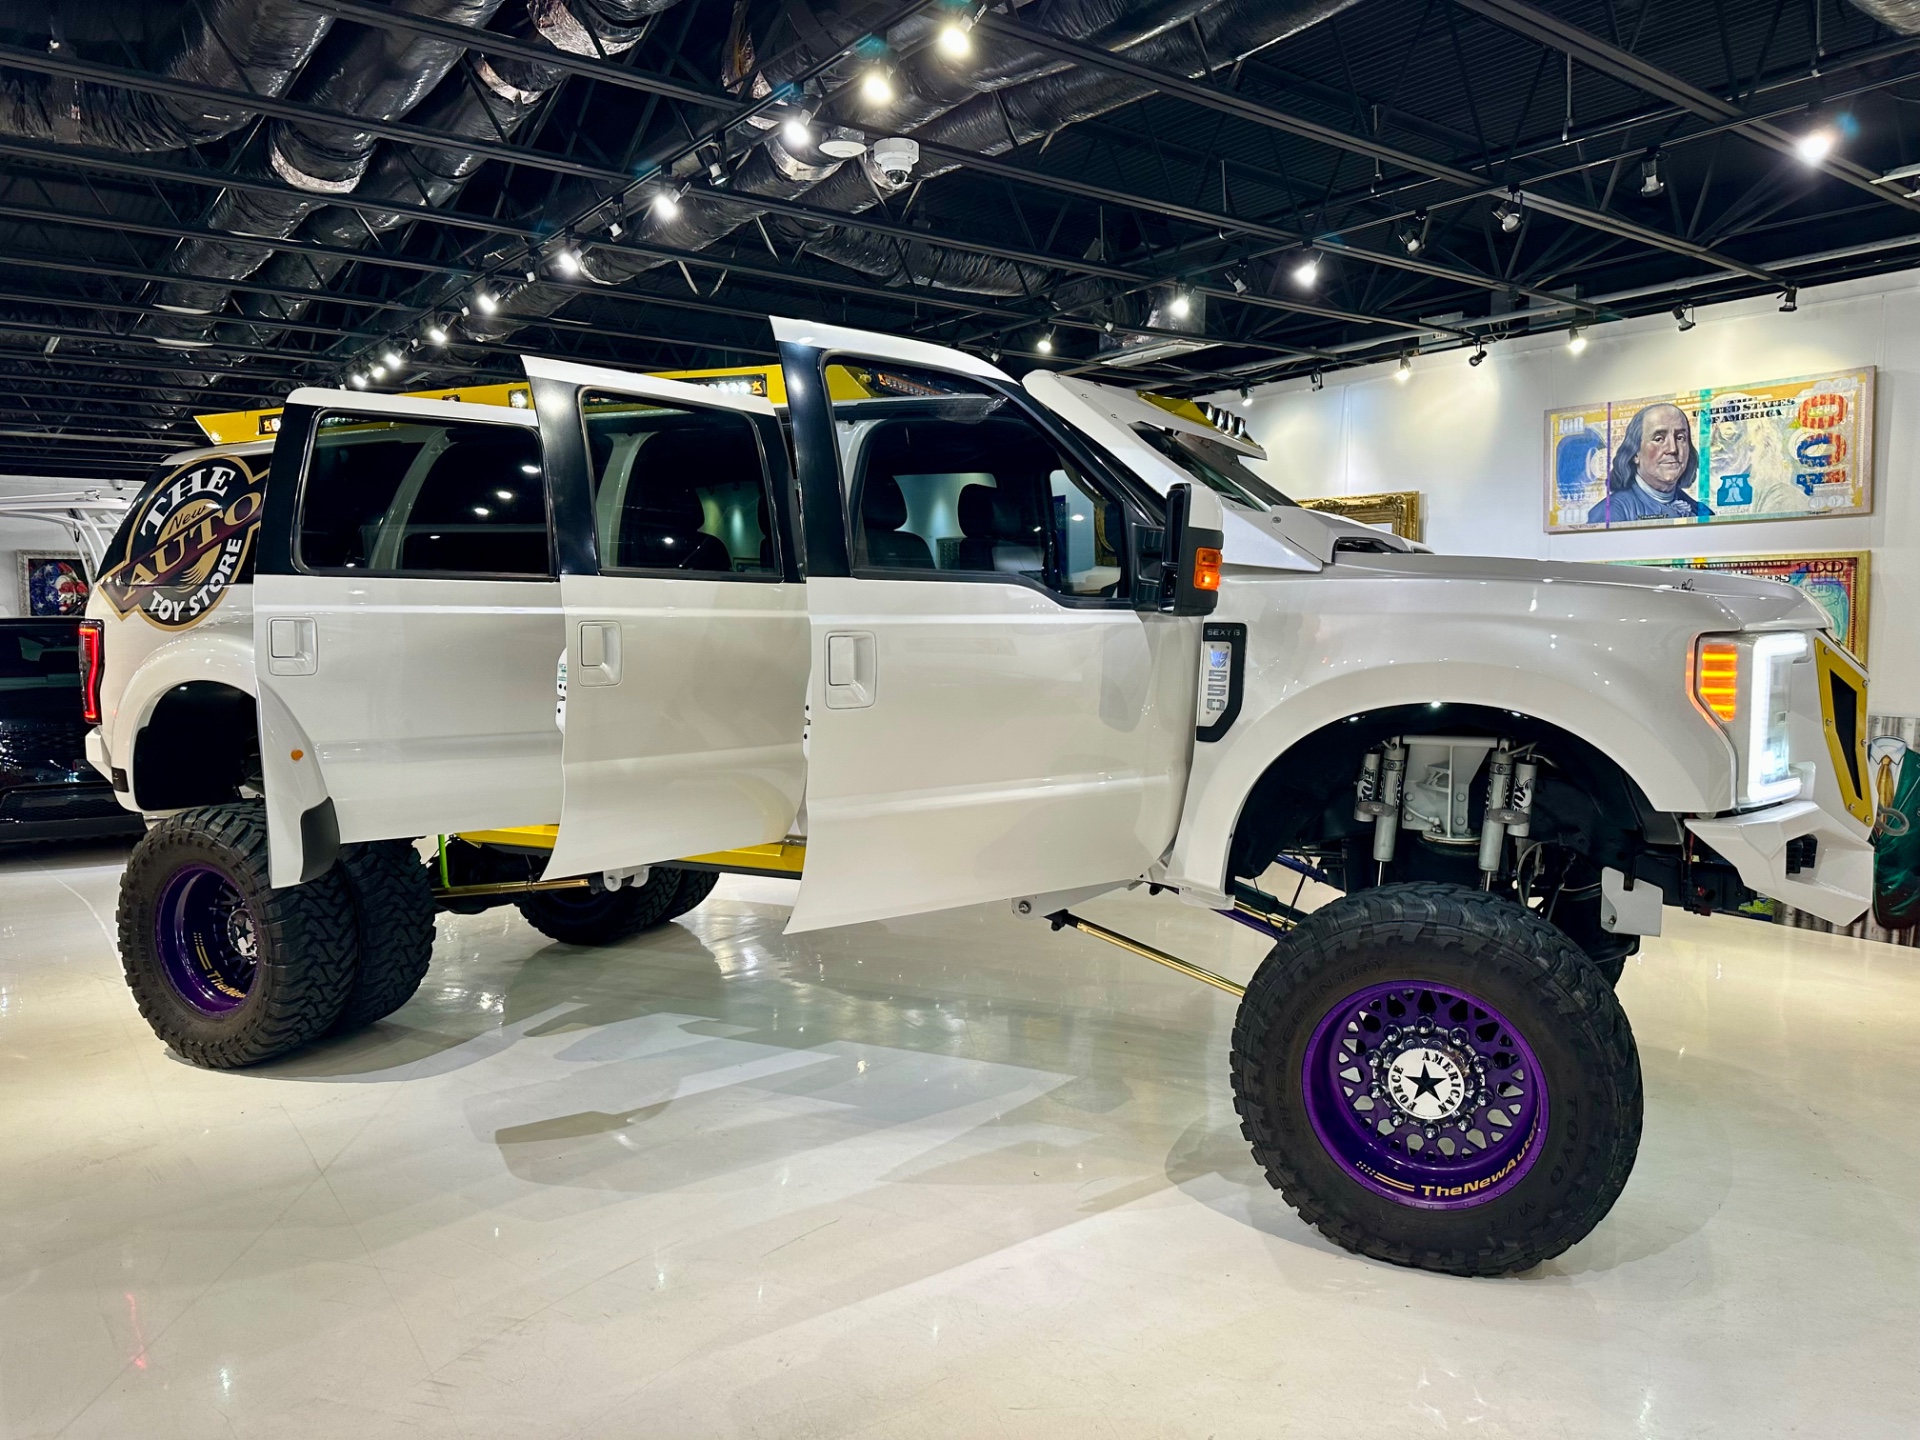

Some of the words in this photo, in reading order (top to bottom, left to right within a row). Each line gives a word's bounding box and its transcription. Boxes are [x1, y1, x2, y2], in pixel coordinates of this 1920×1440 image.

[1692, 402, 1741, 418] UNITED
[1742, 397, 1796, 413] STATES
[1703, 415, 1720, 425] OF
[1720, 408, 1783, 424] AMERICA
[140, 466, 236, 537] THE
[167, 505, 208, 536] New
[122, 492, 262, 600] AUTO
[1796, 560, 1844, 574] 100
[150, 590, 186, 621] TOY
[189, 538, 243, 616] STORE
[1206, 628, 1232, 636] SEXY
[1281, 957, 1388, 1045] COUNTRY
[1391, 1065, 1417, 1112] FORCE
[1422, 1051, 1462, 1115] AMERICAN
[1549, 1094, 1579, 1186] TOYO
